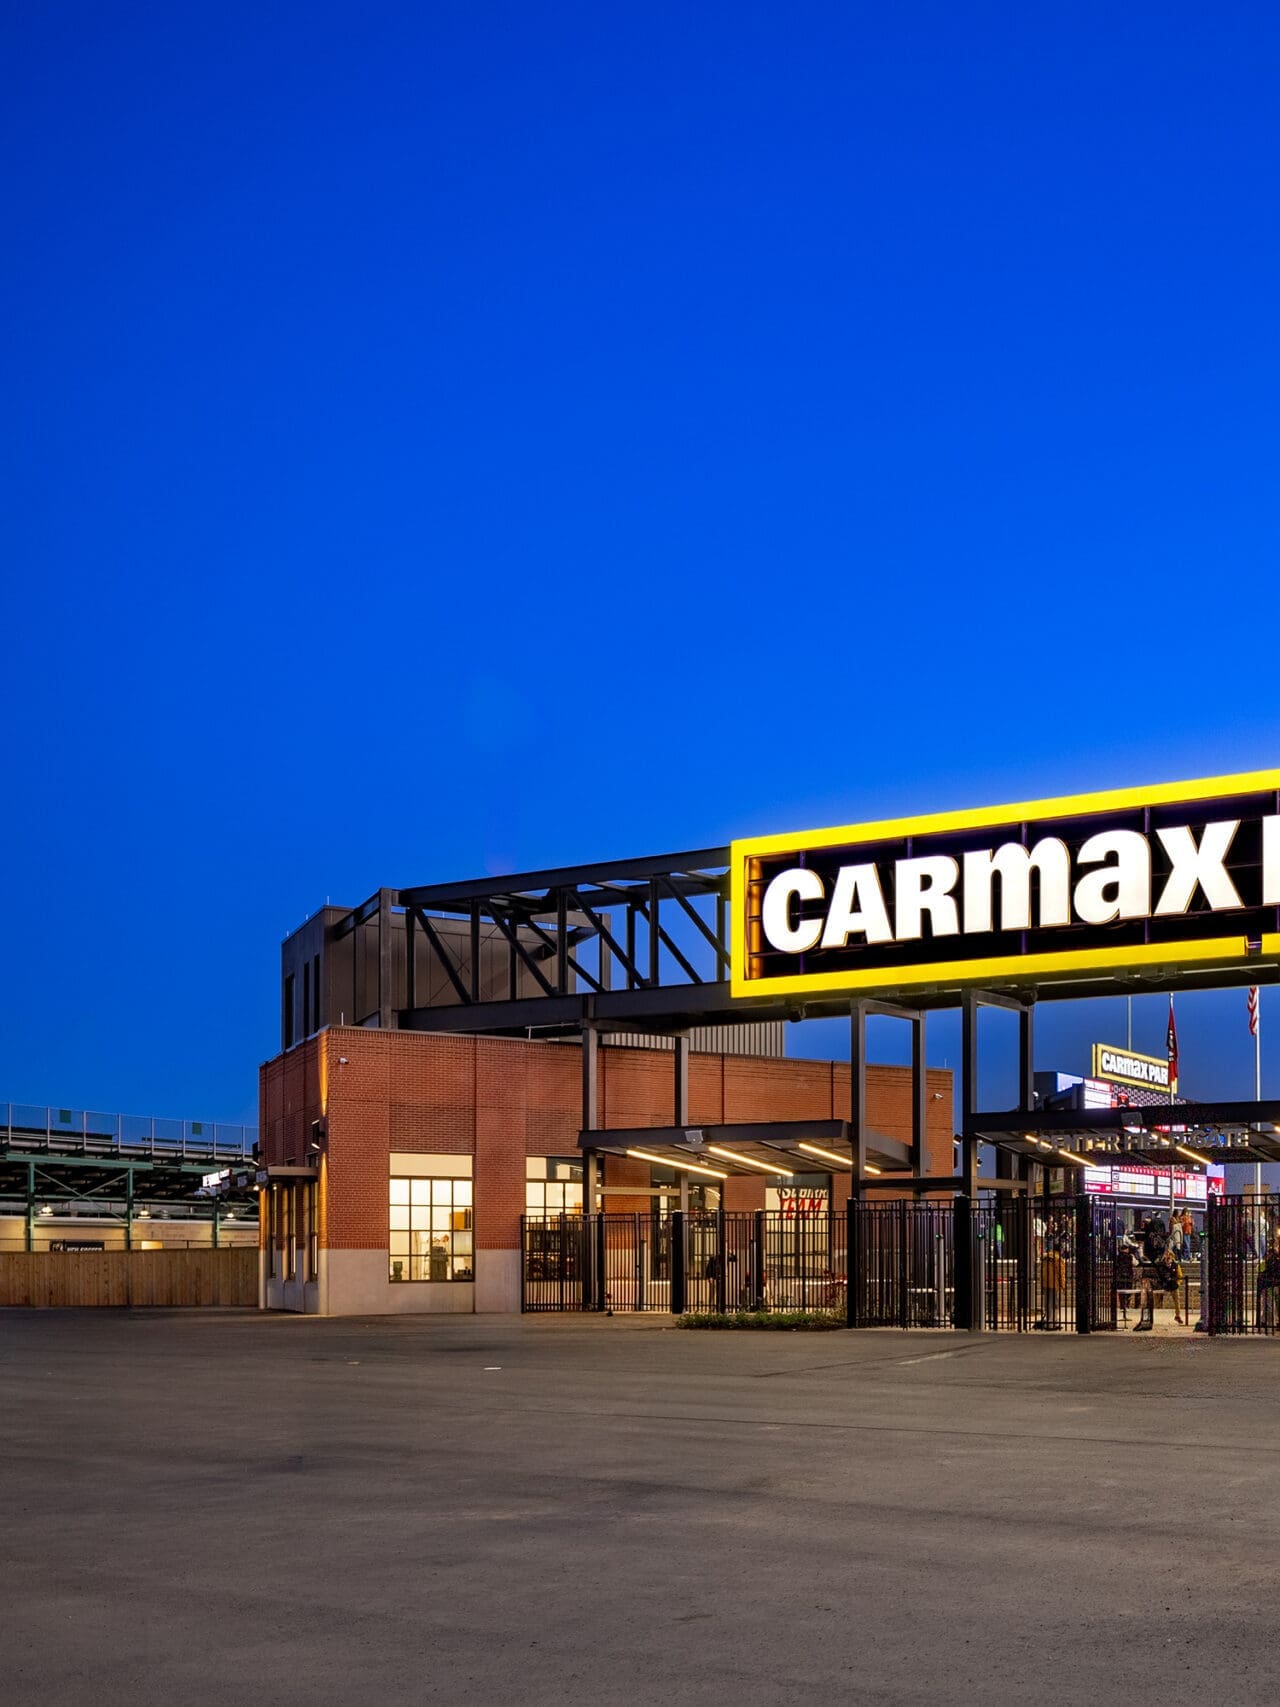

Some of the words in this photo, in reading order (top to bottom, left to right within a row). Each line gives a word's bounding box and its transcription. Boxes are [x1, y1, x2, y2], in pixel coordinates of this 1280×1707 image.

[1149, 1064, 1169, 1085] PAR
[1037, 1132, 1122, 1154] CENTER
[1124, 1128, 1181, 1150] FIELD
[1188, 1123, 1249, 1149] GATE
